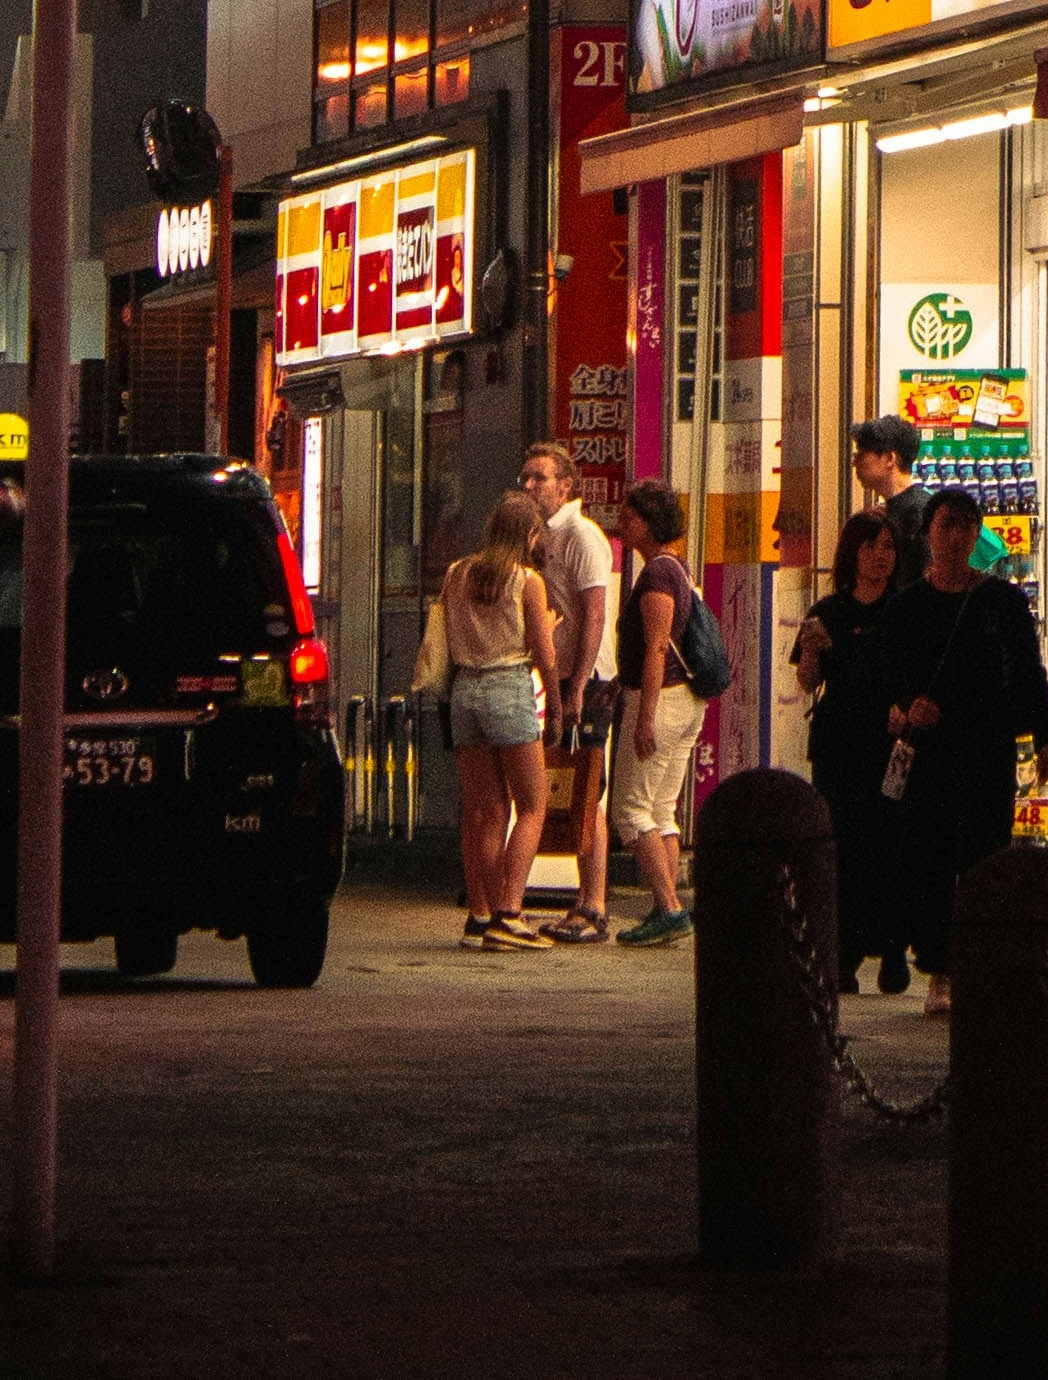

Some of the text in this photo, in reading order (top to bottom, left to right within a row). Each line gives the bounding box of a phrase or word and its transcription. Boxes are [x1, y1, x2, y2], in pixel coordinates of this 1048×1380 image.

[572, 41, 626, 88] 2F
[77, 755, 154, 785] 53-79
[224, 812, 262, 833] km
